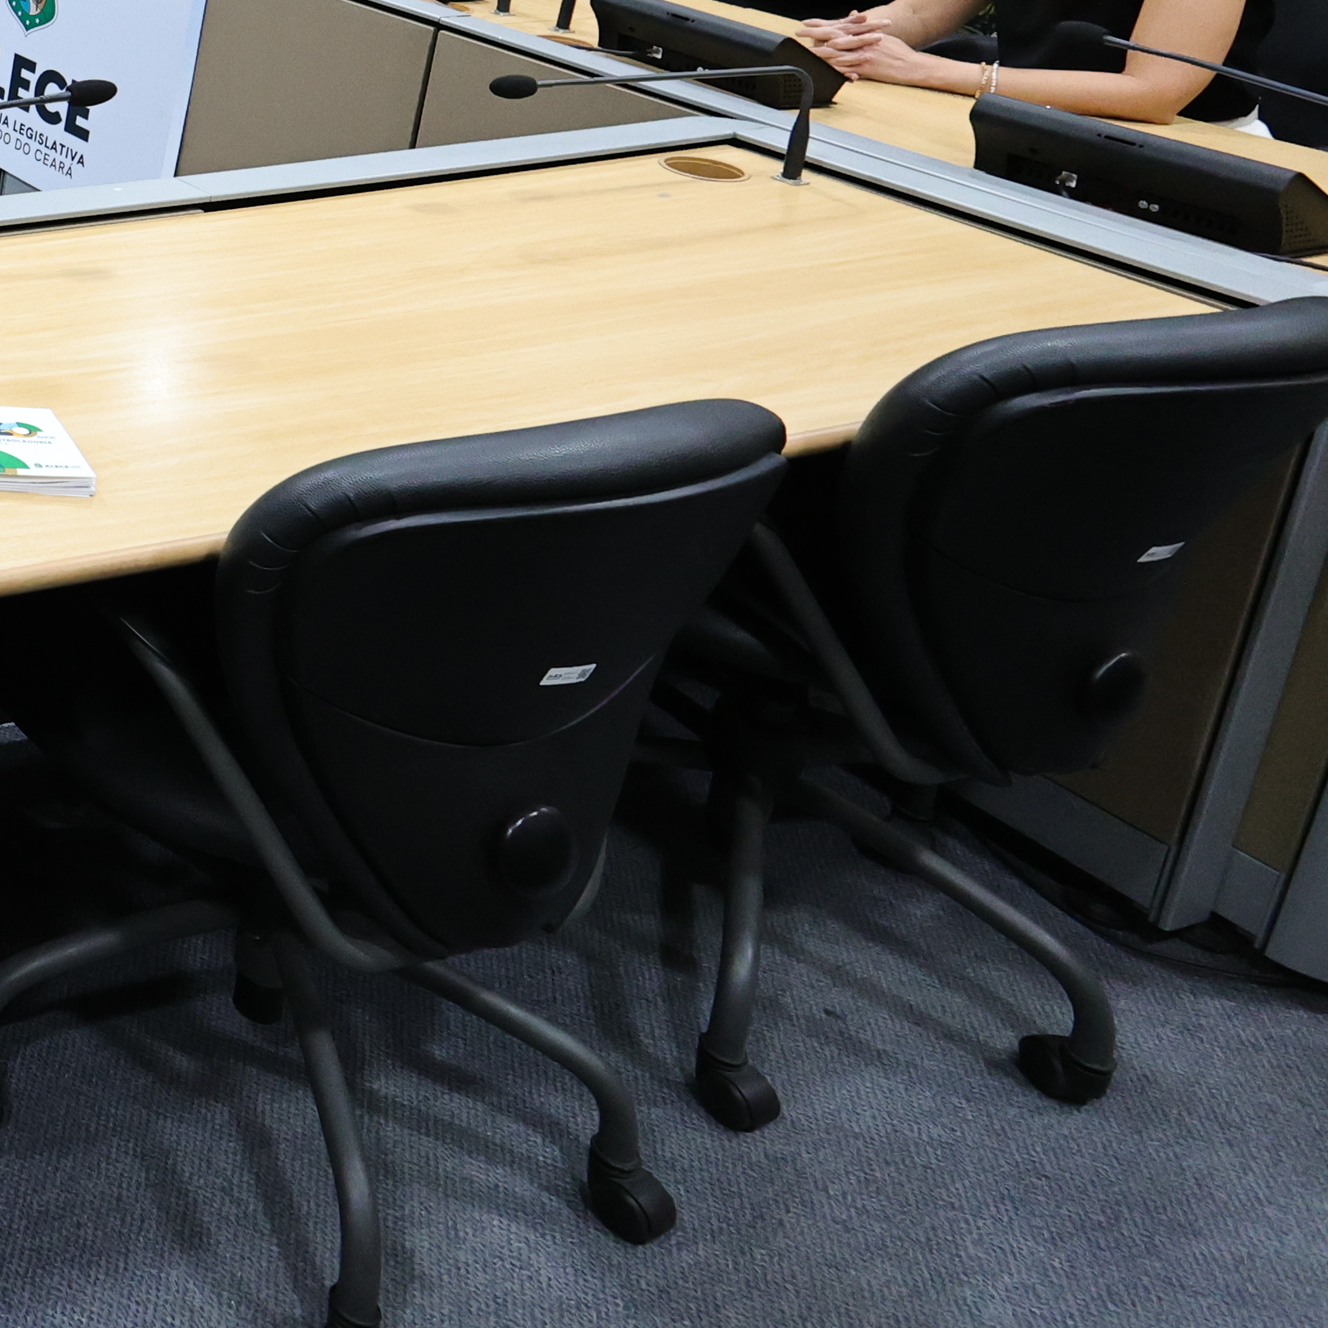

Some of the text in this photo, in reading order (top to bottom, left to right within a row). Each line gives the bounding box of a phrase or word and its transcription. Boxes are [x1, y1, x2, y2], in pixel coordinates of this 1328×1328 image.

[12, 119, 86, 168] LEGISLATIVA
[14, 137, 31, 156] DO
[34, 148, 74, 179] CEARÁ
